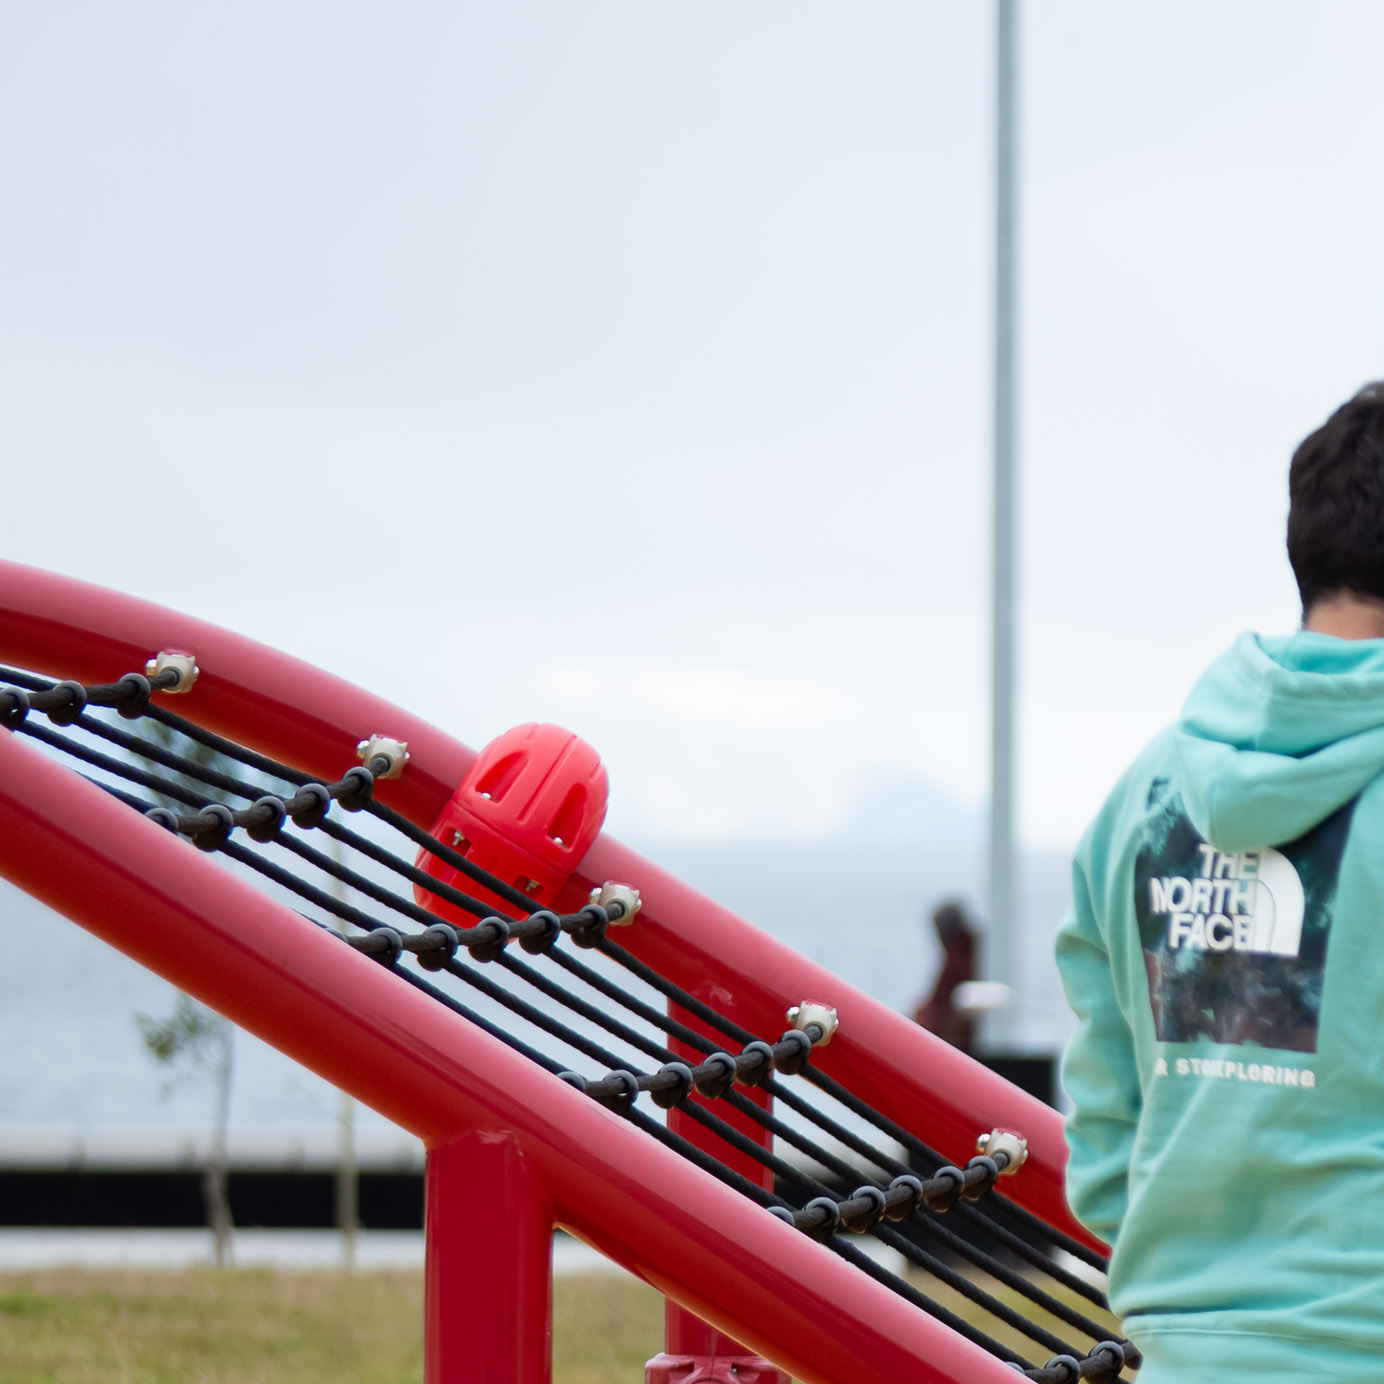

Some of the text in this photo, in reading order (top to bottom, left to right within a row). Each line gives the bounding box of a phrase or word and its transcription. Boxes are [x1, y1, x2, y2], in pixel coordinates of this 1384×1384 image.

[1199, 843, 1259, 879] THE
[1150, 876, 1257, 915] NORTH
[1168, 913, 1254, 951] FACE
